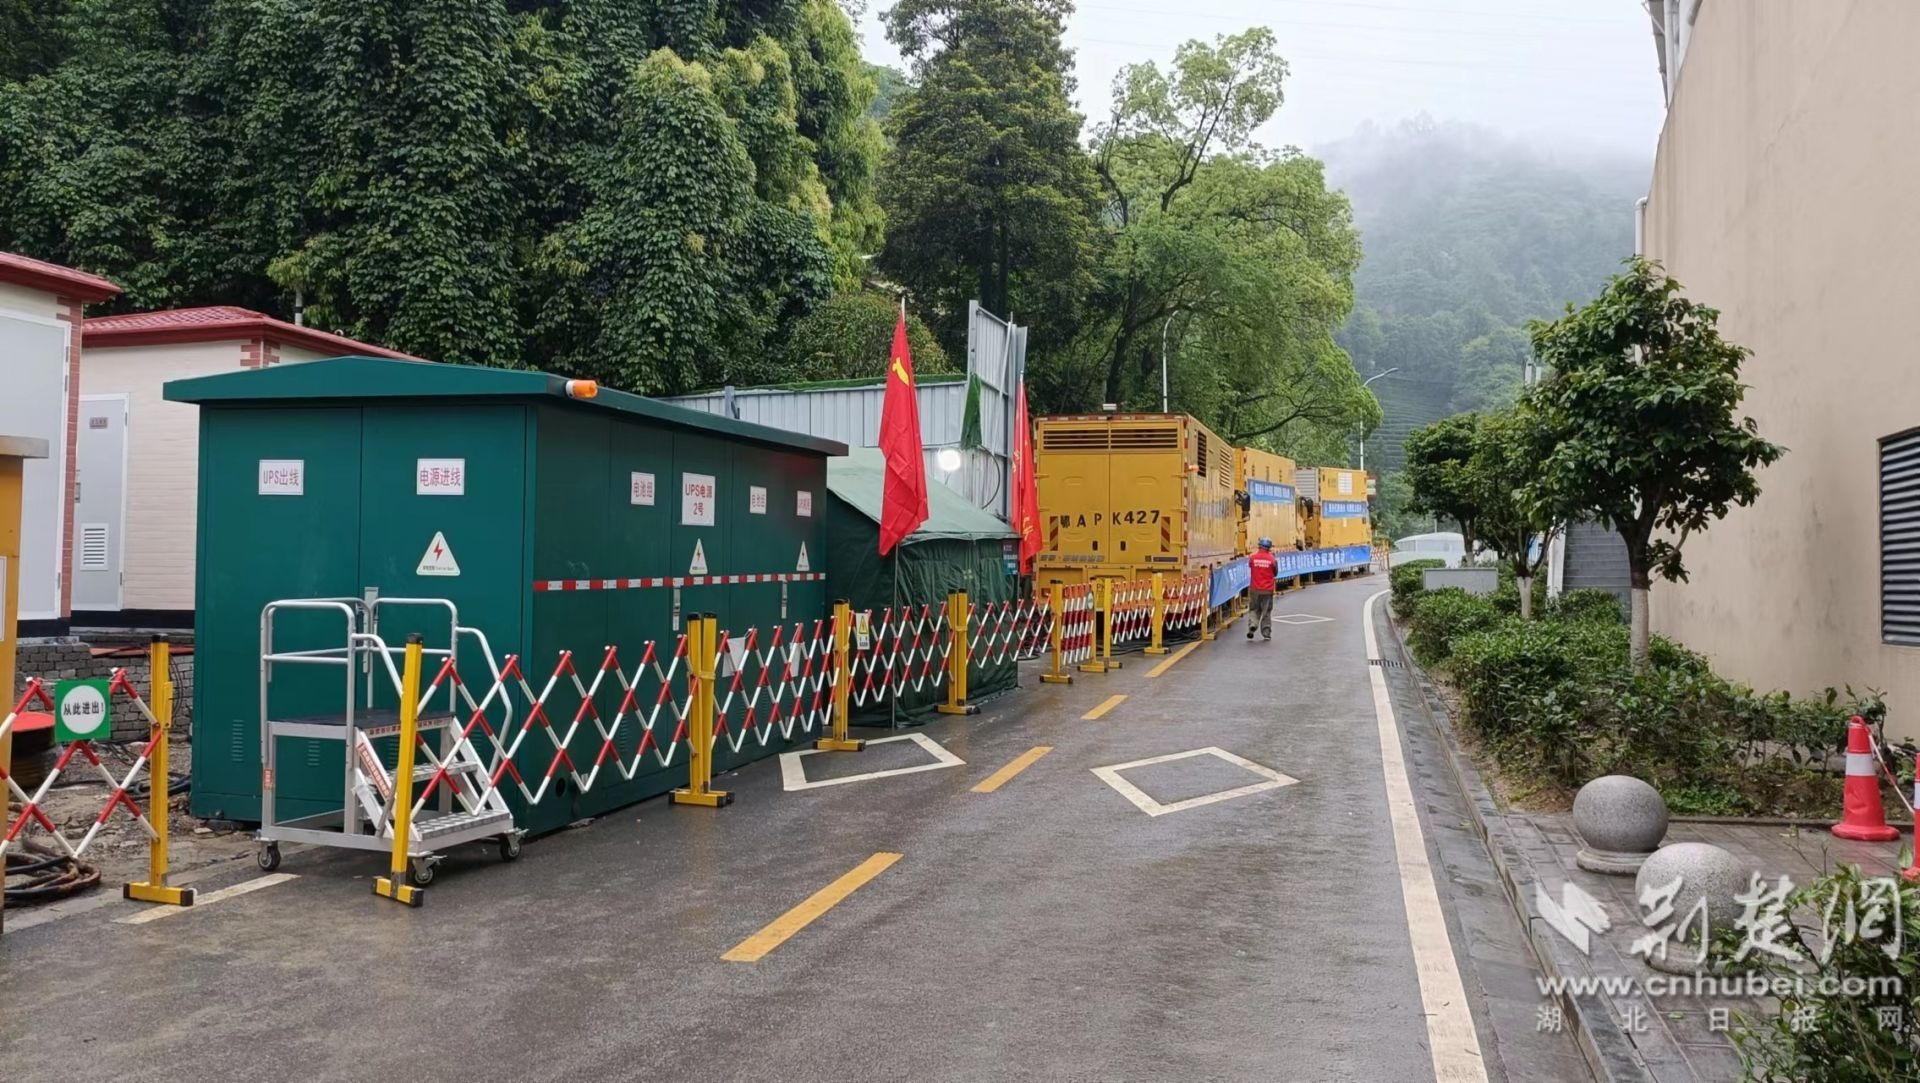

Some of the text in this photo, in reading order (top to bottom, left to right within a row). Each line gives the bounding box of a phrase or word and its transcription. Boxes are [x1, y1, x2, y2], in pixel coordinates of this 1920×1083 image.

[263, 469, 300, 486] UPS出线
[420, 468, 461, 487] 电源进线
[685, 484, 713, 499] UPS电源
[693, 503, 704, 516] 2号
